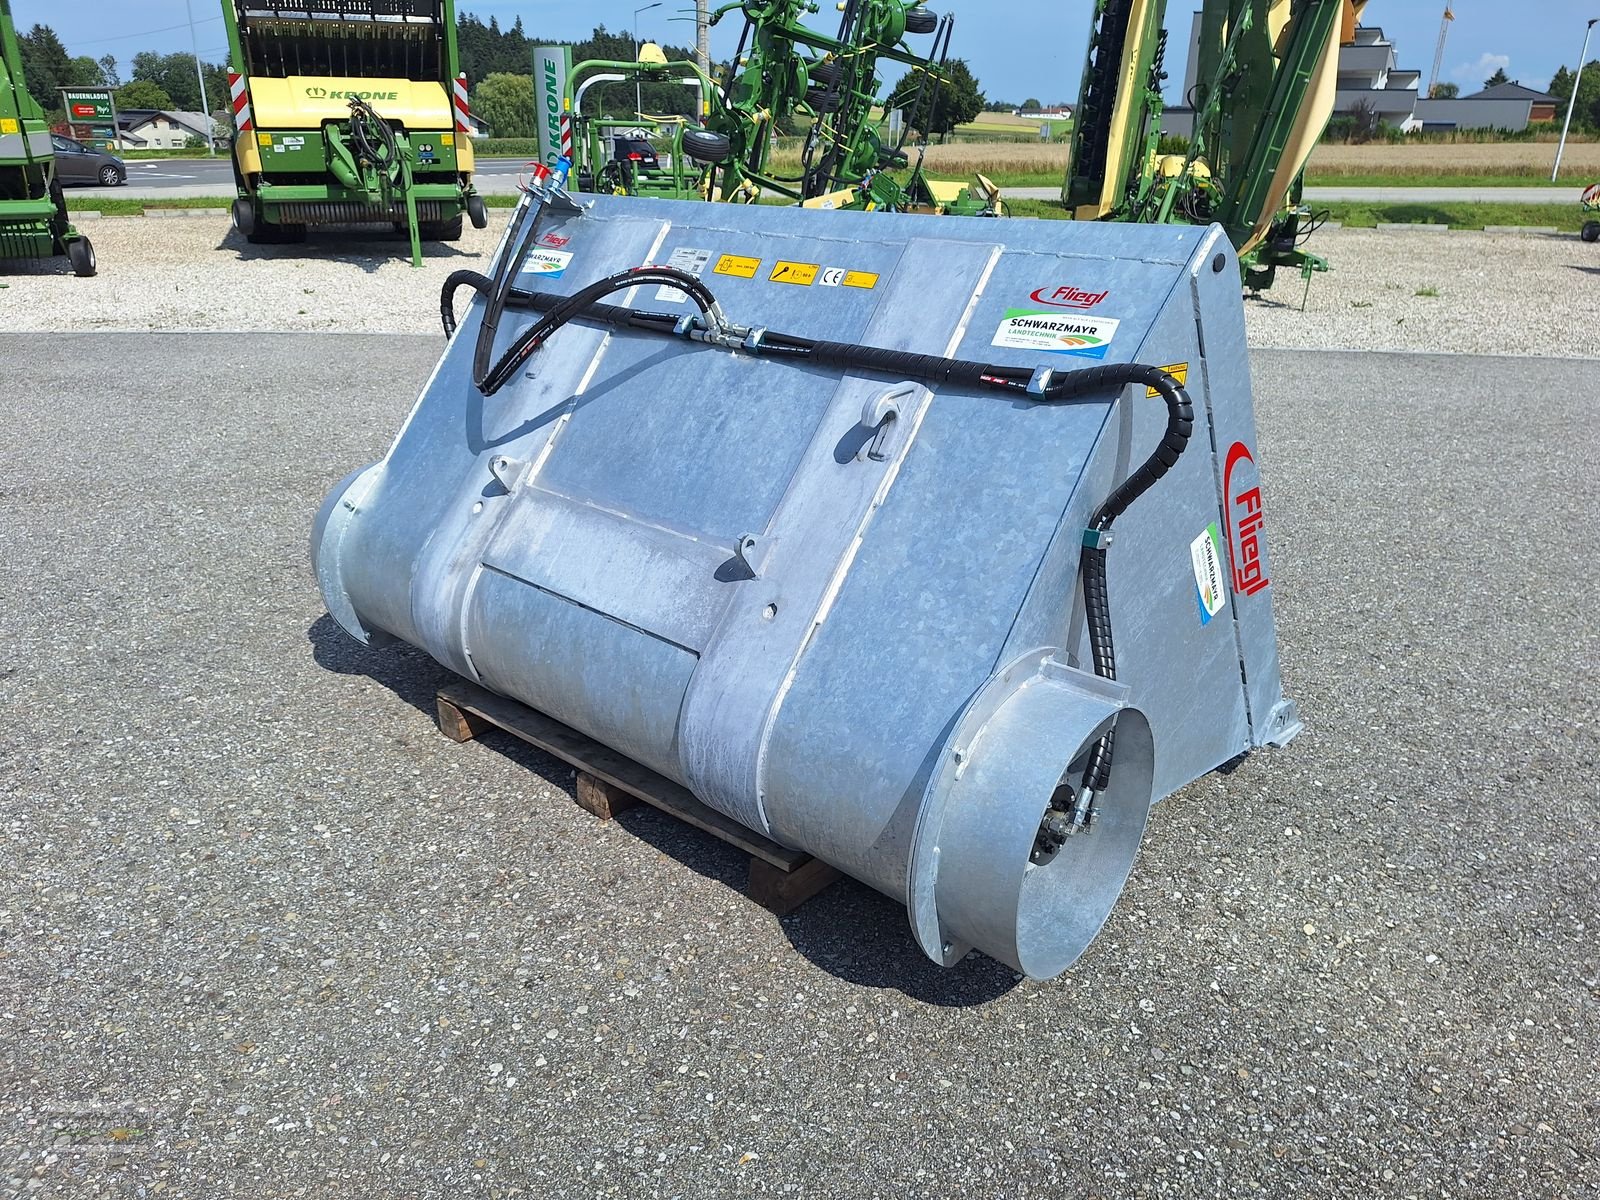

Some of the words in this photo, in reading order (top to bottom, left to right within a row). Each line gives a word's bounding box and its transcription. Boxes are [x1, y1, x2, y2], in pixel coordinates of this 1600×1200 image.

[67, 92, 109, 100] BAUERNLADEN
[329, 91, 398, 101] KRONE
[543, 58, 561, 150] KRONE
[541, 233, 571, 249] Fliegl
[1051, 285, 1109, 307] Fliegl
[1007, 328, 1058, 339] LANDTECHNIK
[1010, 317, 1098, 335] SCHWARZMAYR
[1236, 487, 1269, 597] Fliegl
[1204, 536, 1219, 601] SCHWARZMAYR
